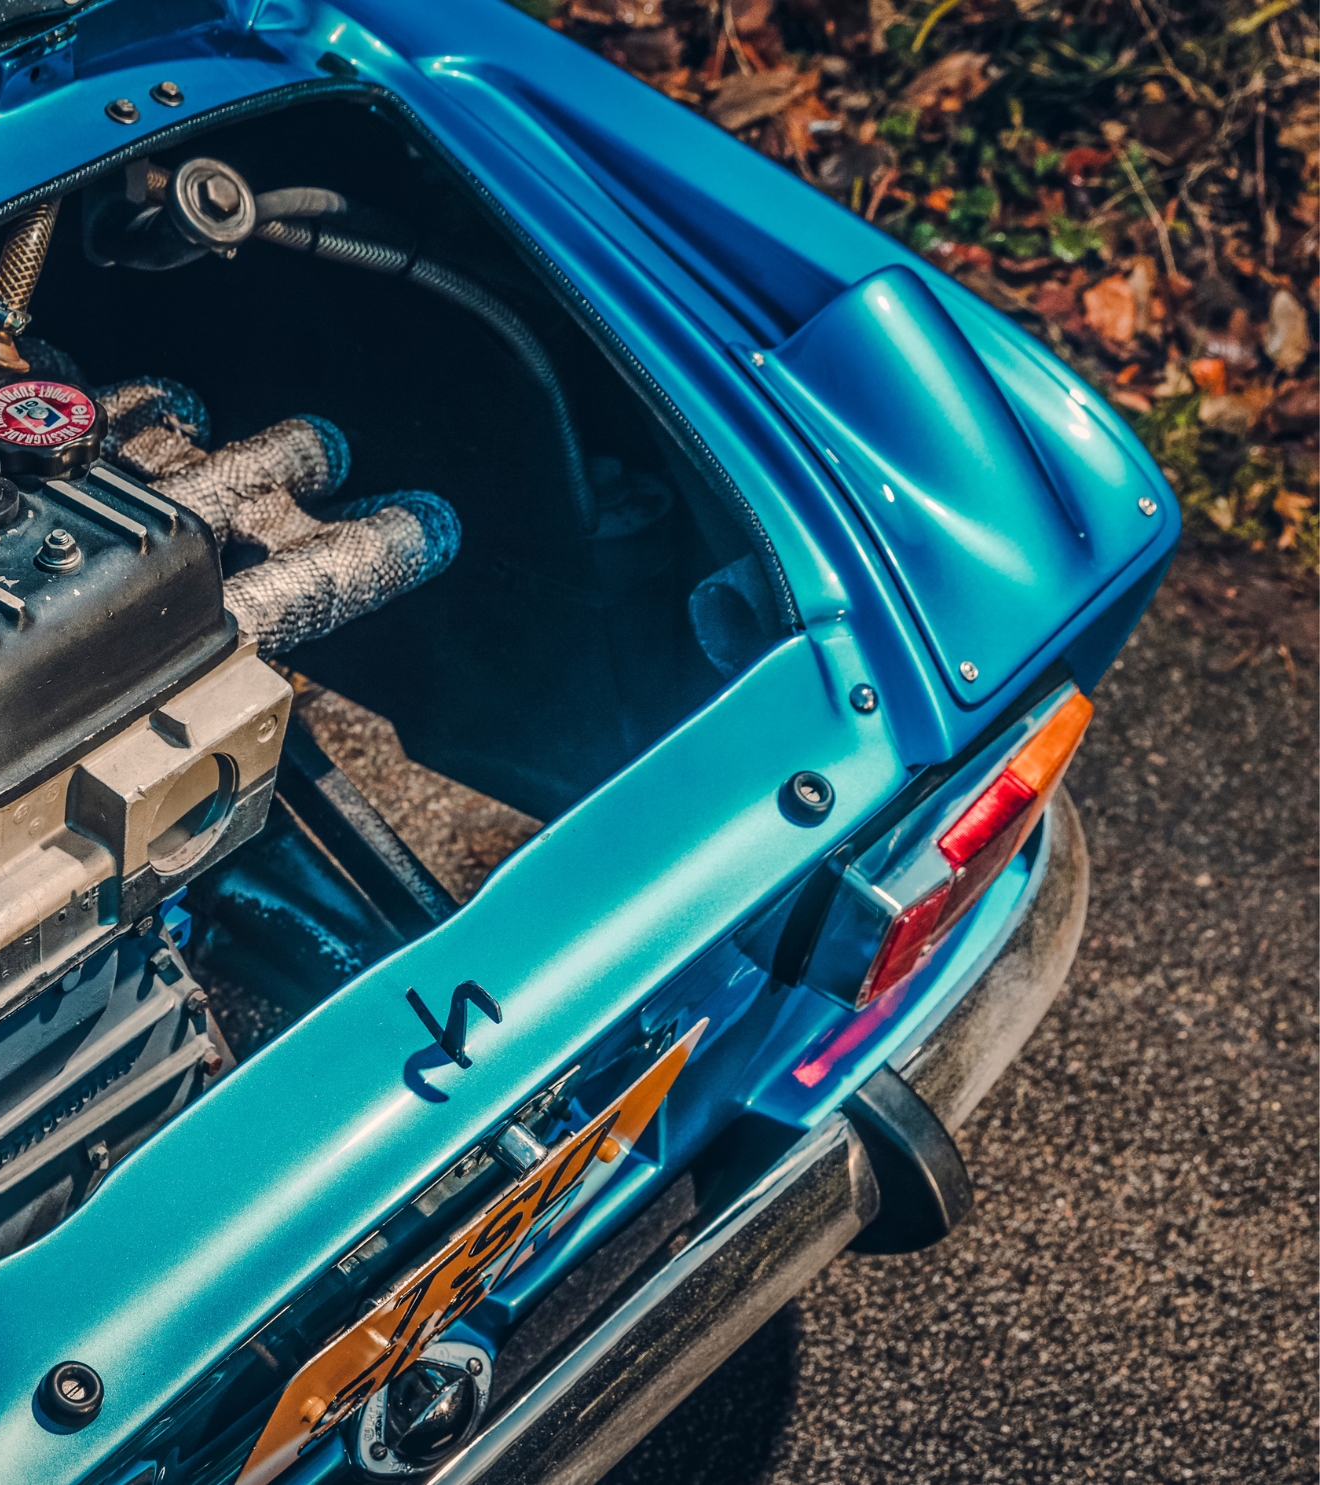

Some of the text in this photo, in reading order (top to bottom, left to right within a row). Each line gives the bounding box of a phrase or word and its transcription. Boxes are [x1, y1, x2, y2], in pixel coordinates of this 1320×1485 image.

[39, 385, 76, 403] SPORT
[0, 404, 91, 444] elf PRESTIGRADE
